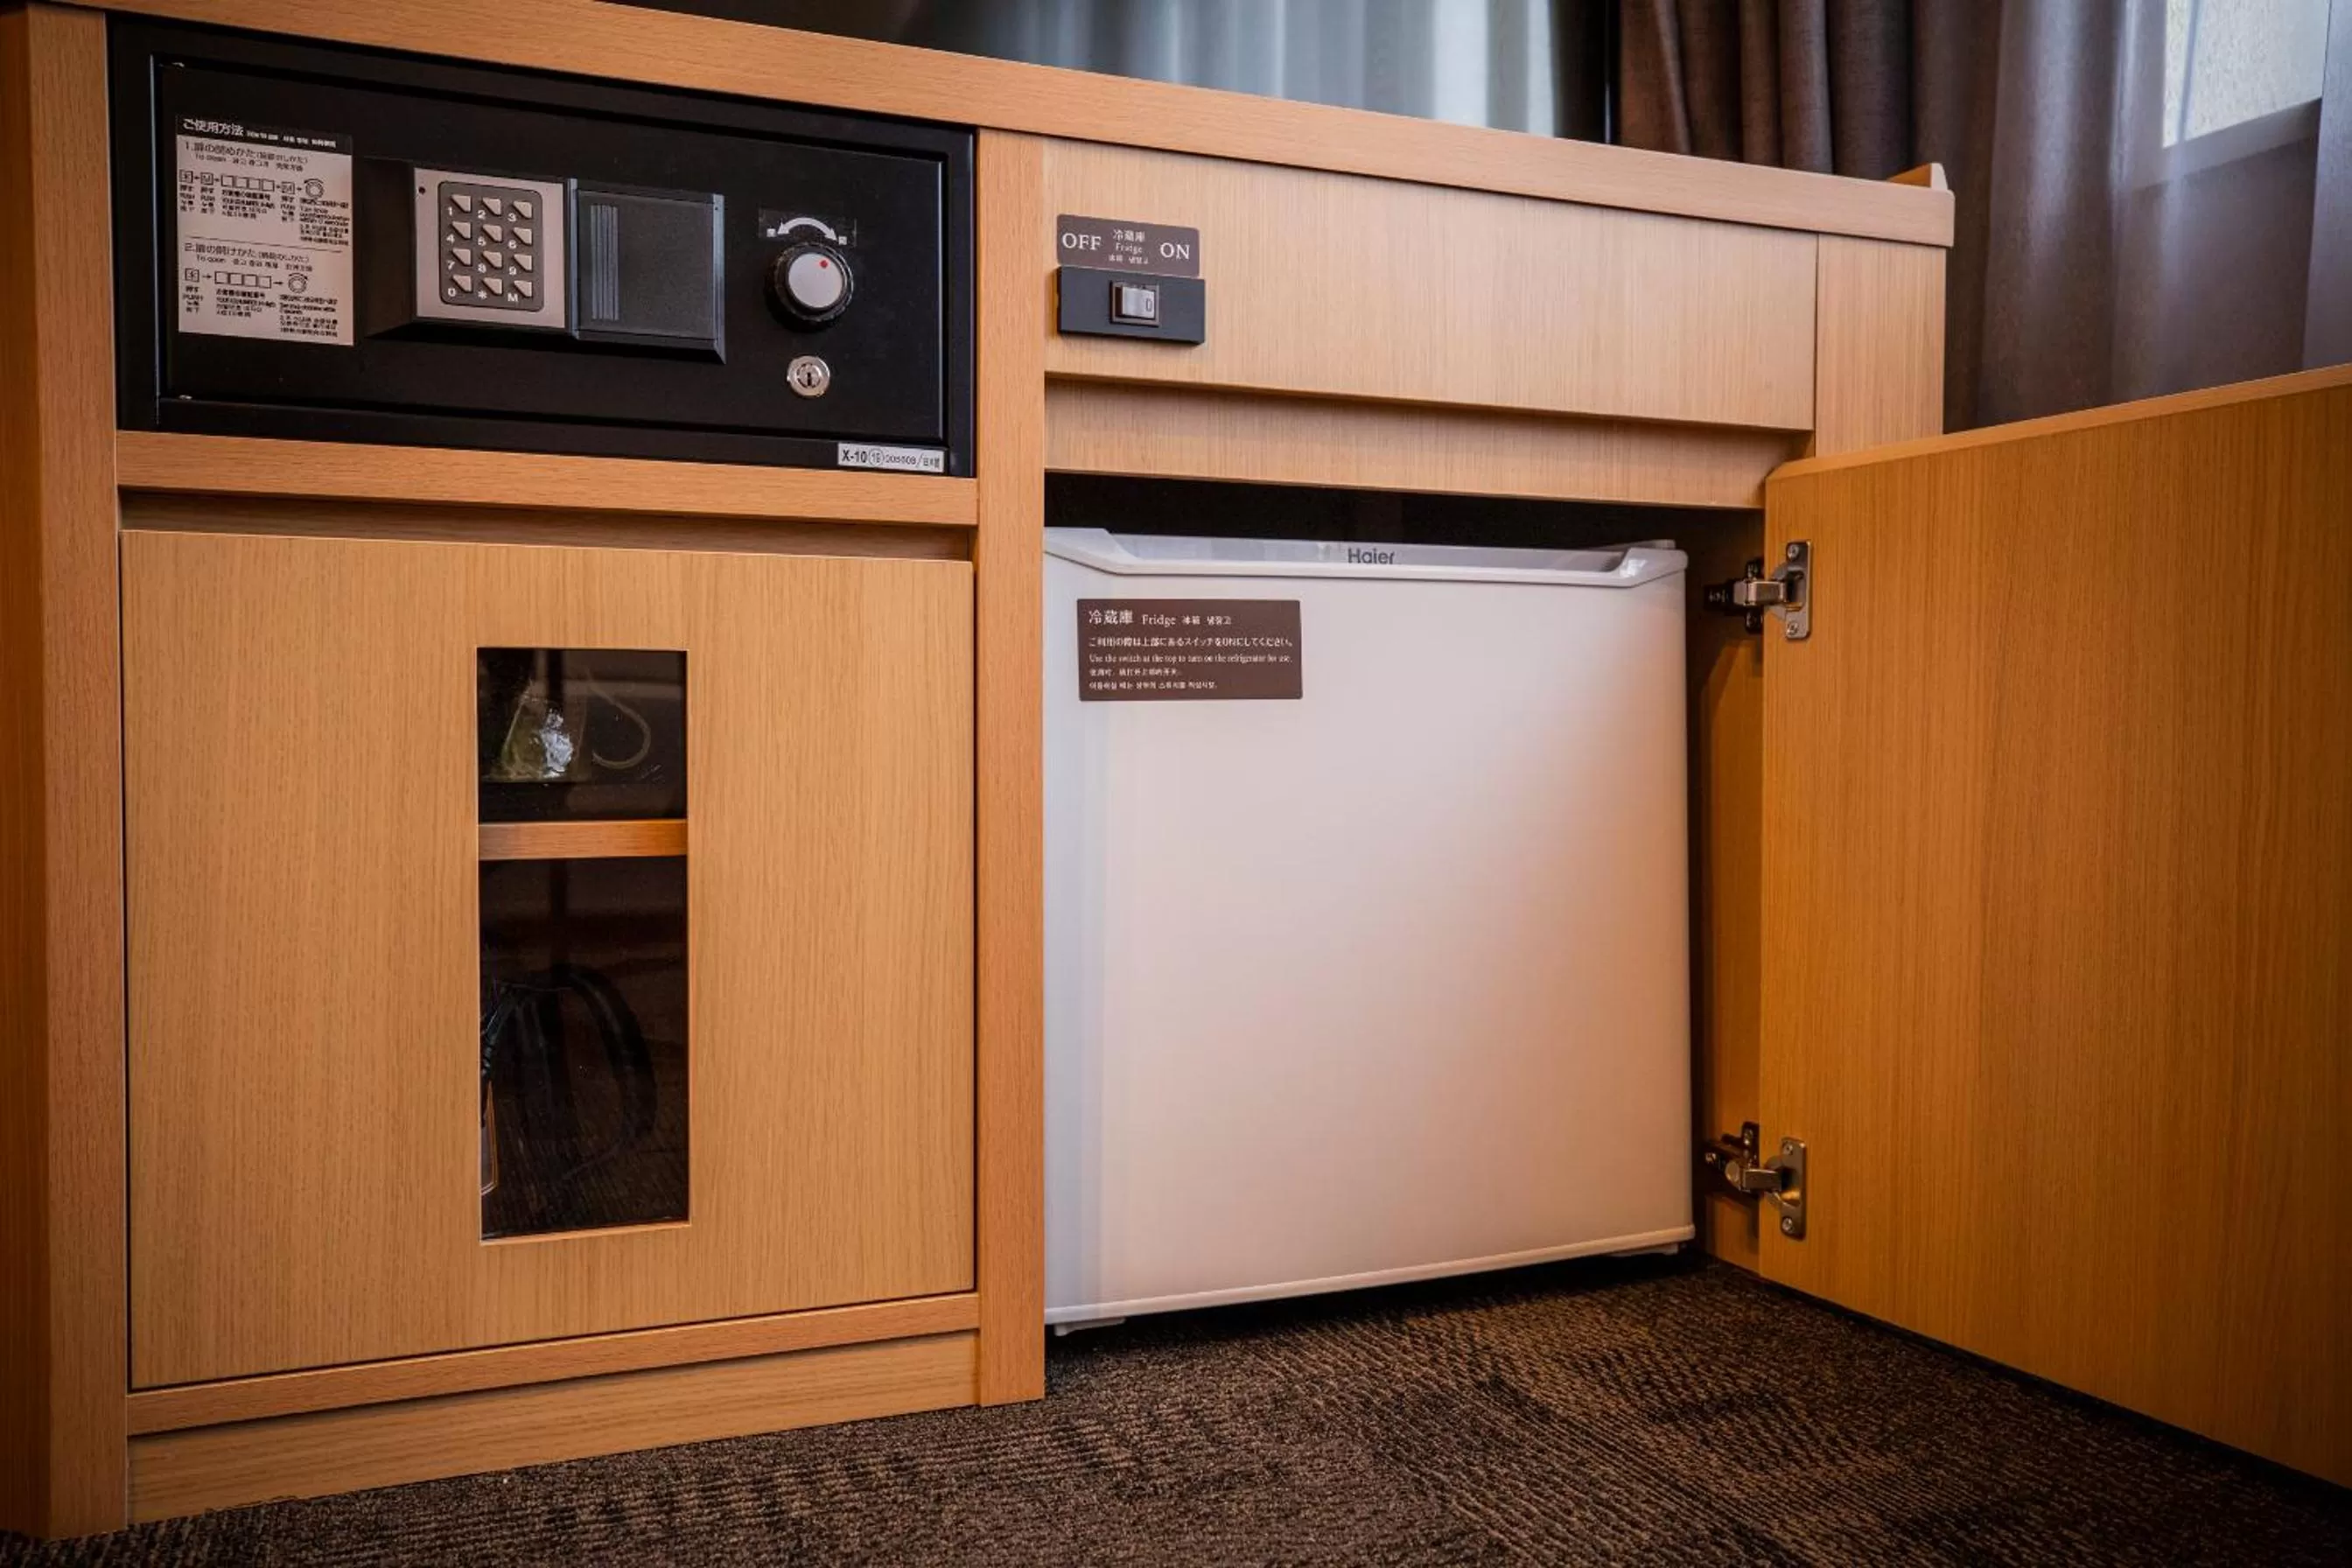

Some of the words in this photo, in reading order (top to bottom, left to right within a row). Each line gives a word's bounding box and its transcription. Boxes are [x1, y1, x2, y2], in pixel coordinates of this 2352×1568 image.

[448, 206, 453, 216] 1
[478, 210, 486, 220] 2
[508, 213, 517, 222] 3
[446, 234, 455, 243] 4
[478, 236, 486, 246] 5
[508, 240, 517, 248] 6
[1061, 232, 1102, 251] OFF
[1116, 242, 1144, 255] Fridge
[1160, 242, 1190, 260] ON
[447, 260, 455, 270] 7
[478, 263, 486, 273] 8
[508, 266, 517, 275] 9
[508, 292, 518, 302] M
[842, 449, 868, 464] X-10
[1348, 547, 1396, 564] Haier
[1088, 609, 1134, 625] 冷蔵庫
[1142, 613, 1177, 627] Fridge
[1089, 654, 1102, 662] Use
[1104, 653, 1117, 662] the
[1119, 654, 1141, 662] switch
[1152, 654, 1164, 662] the
[1165, 654, 1177, 664] top
[1214, 654, 1227, 662] the
